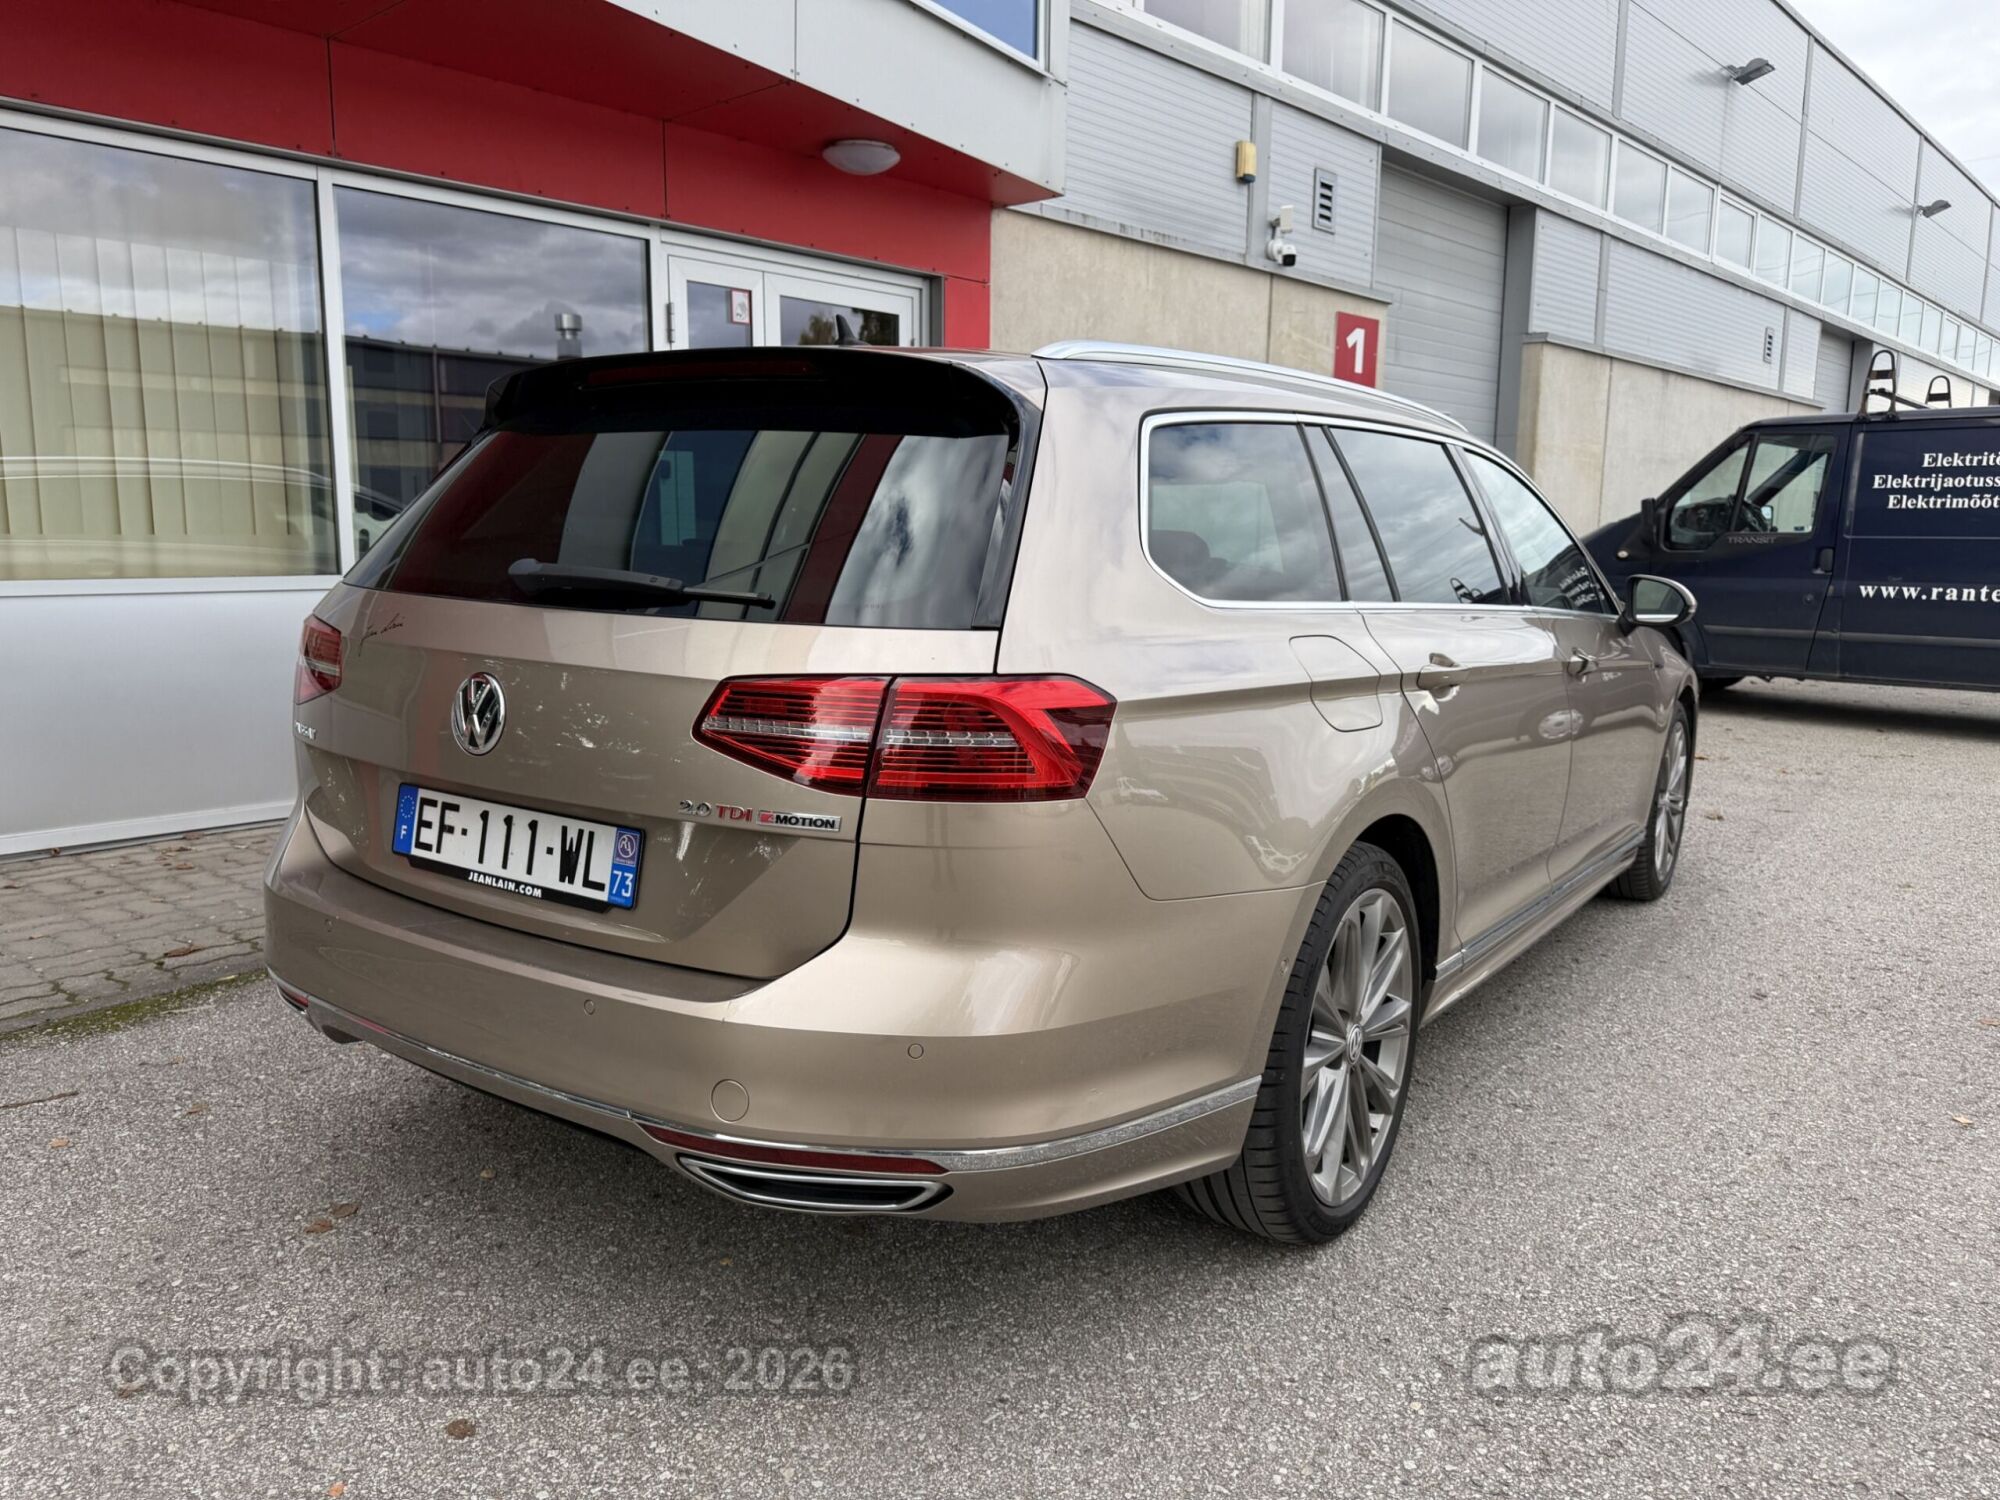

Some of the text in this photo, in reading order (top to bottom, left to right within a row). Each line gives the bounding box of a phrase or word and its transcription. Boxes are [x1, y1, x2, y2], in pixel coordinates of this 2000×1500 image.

[1345, 327, 1366, 375] 1
[1728, 536, 1776, 544] TRANSIT
[678, 800, 711, 818] 2.0
[716, 804, 752, 822] TDI
[400, 825, 408, 839] F
[414, 796, 606, 892] EF-111-WL
[468, 871, 542, 899] JEANLAIN.COM
[612, 870, 634, 897] 73
